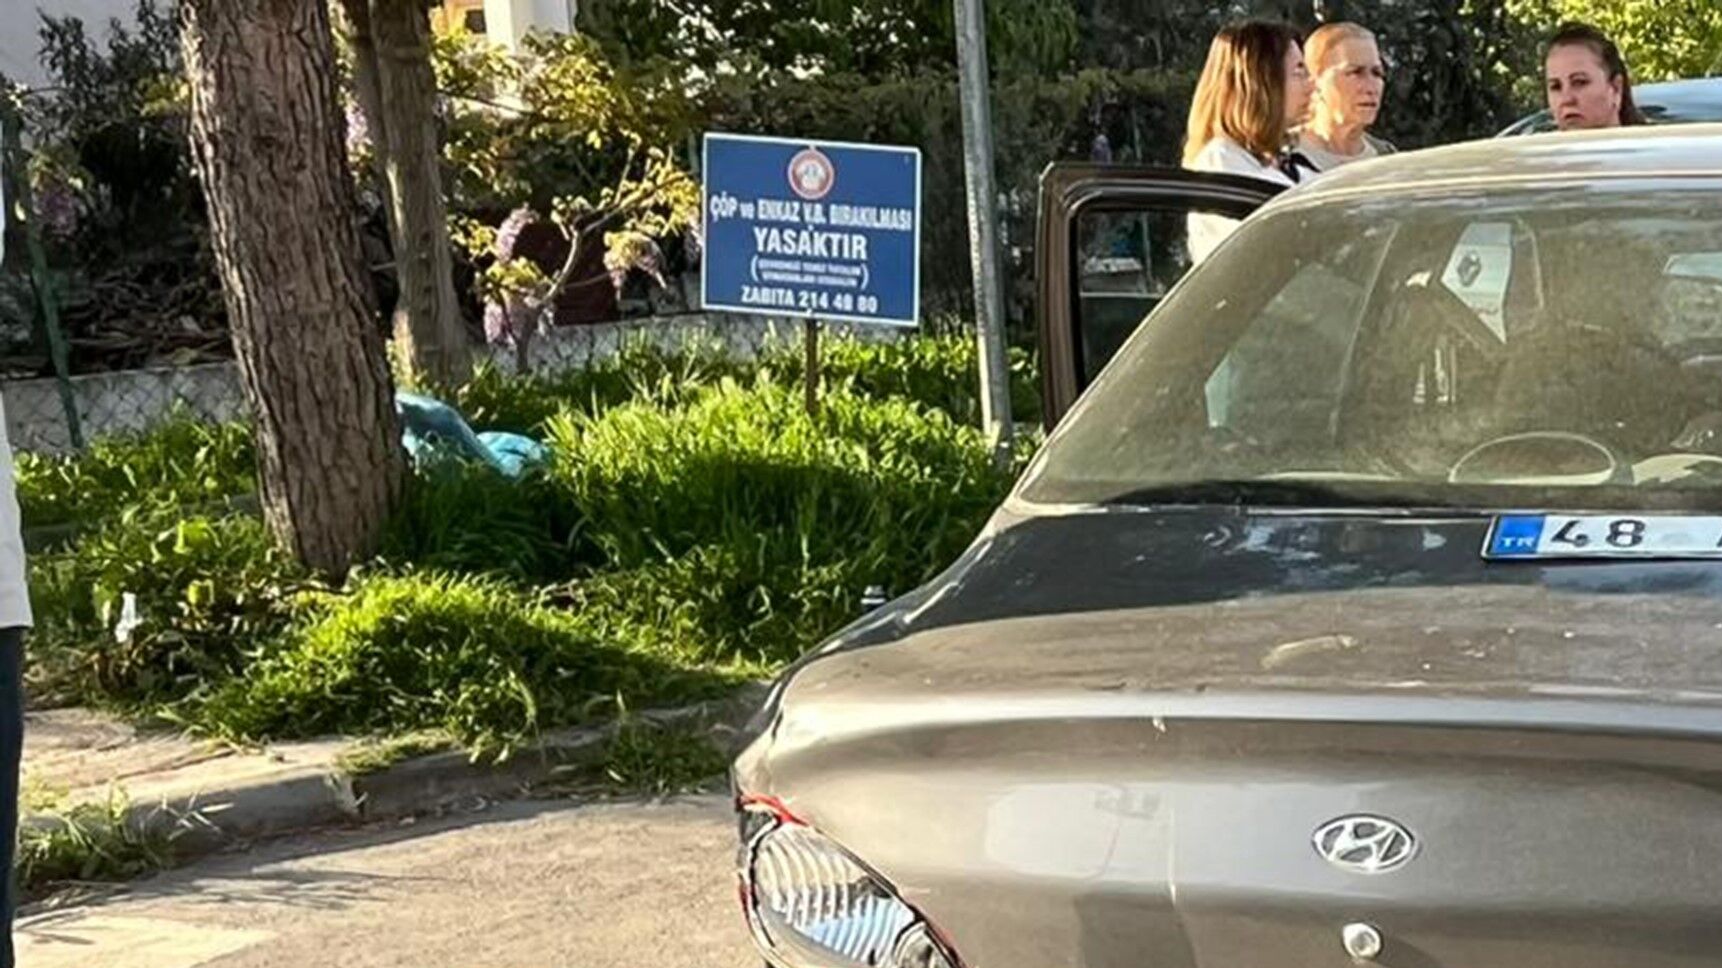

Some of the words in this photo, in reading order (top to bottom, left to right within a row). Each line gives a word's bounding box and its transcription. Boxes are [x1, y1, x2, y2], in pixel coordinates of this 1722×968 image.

[710, 191, 738, 223] ÇÖP
[740, 203, 755, 219] ve
[758, 199, 800, 222] ENKAZ
[830, 204, 912, 231] BIRAKILMASI
[753, 226, 868, 260] YASAKTIR
[741, 285, 796, 306] ZABITA
[798, 290, 829, 310] 214
[1500, 536, 1535, 548] TR
[1550, 518, 1647, 549] 48
